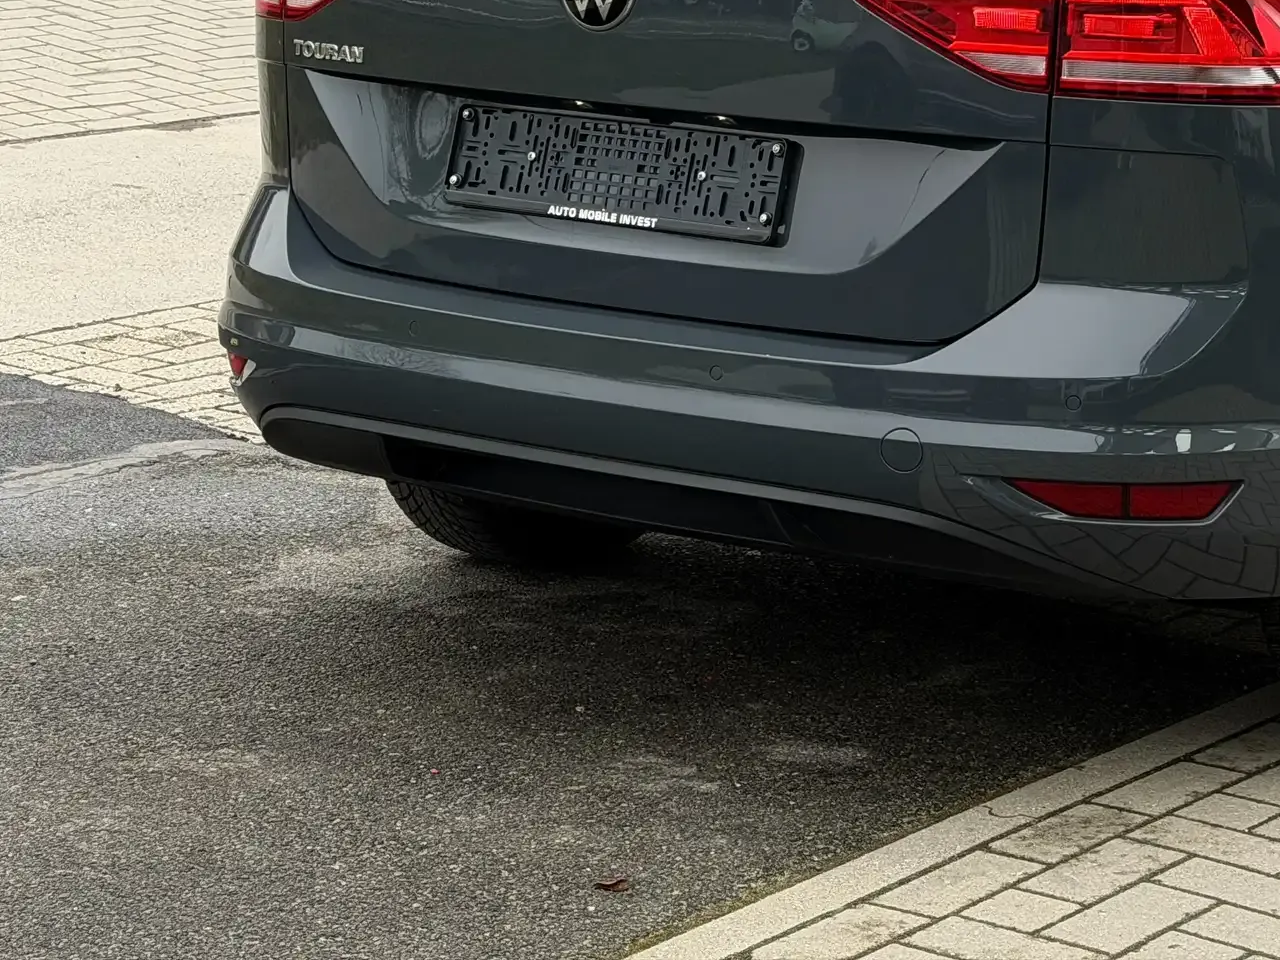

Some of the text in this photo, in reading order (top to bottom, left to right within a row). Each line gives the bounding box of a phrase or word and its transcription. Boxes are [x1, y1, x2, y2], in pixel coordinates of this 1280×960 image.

[293, 38, 365, 64] TOURAN
[547, 205, 658, 228] AUTO MOBILE INVEST
